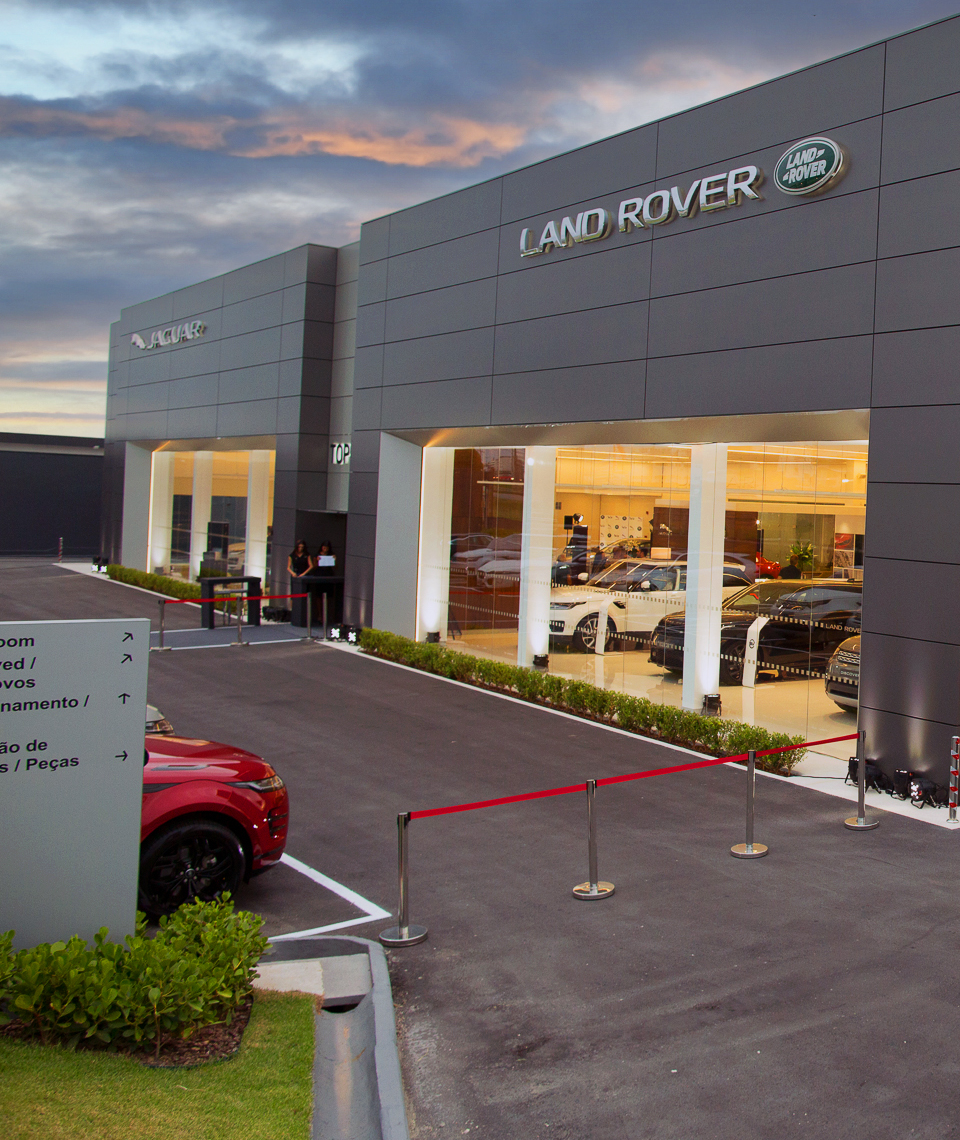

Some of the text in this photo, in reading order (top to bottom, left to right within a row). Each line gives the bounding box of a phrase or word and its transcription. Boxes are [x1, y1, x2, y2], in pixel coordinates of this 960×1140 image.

[786, 147, 817, 170] LAND
[788, 159, 827, 184] ROVER
[520, 165, 760, 258] LAND ROVER
[146, 320, 204, 350] JAGUAR
[825, 623, 843, 631] LAND
[0, 657, 25, 671] ed
[0, 678, 36, 690] vos
[1, 696, 79, 713] namento
[26, 739, 48, 752] de
[26, 757, 80, 772] Peças
